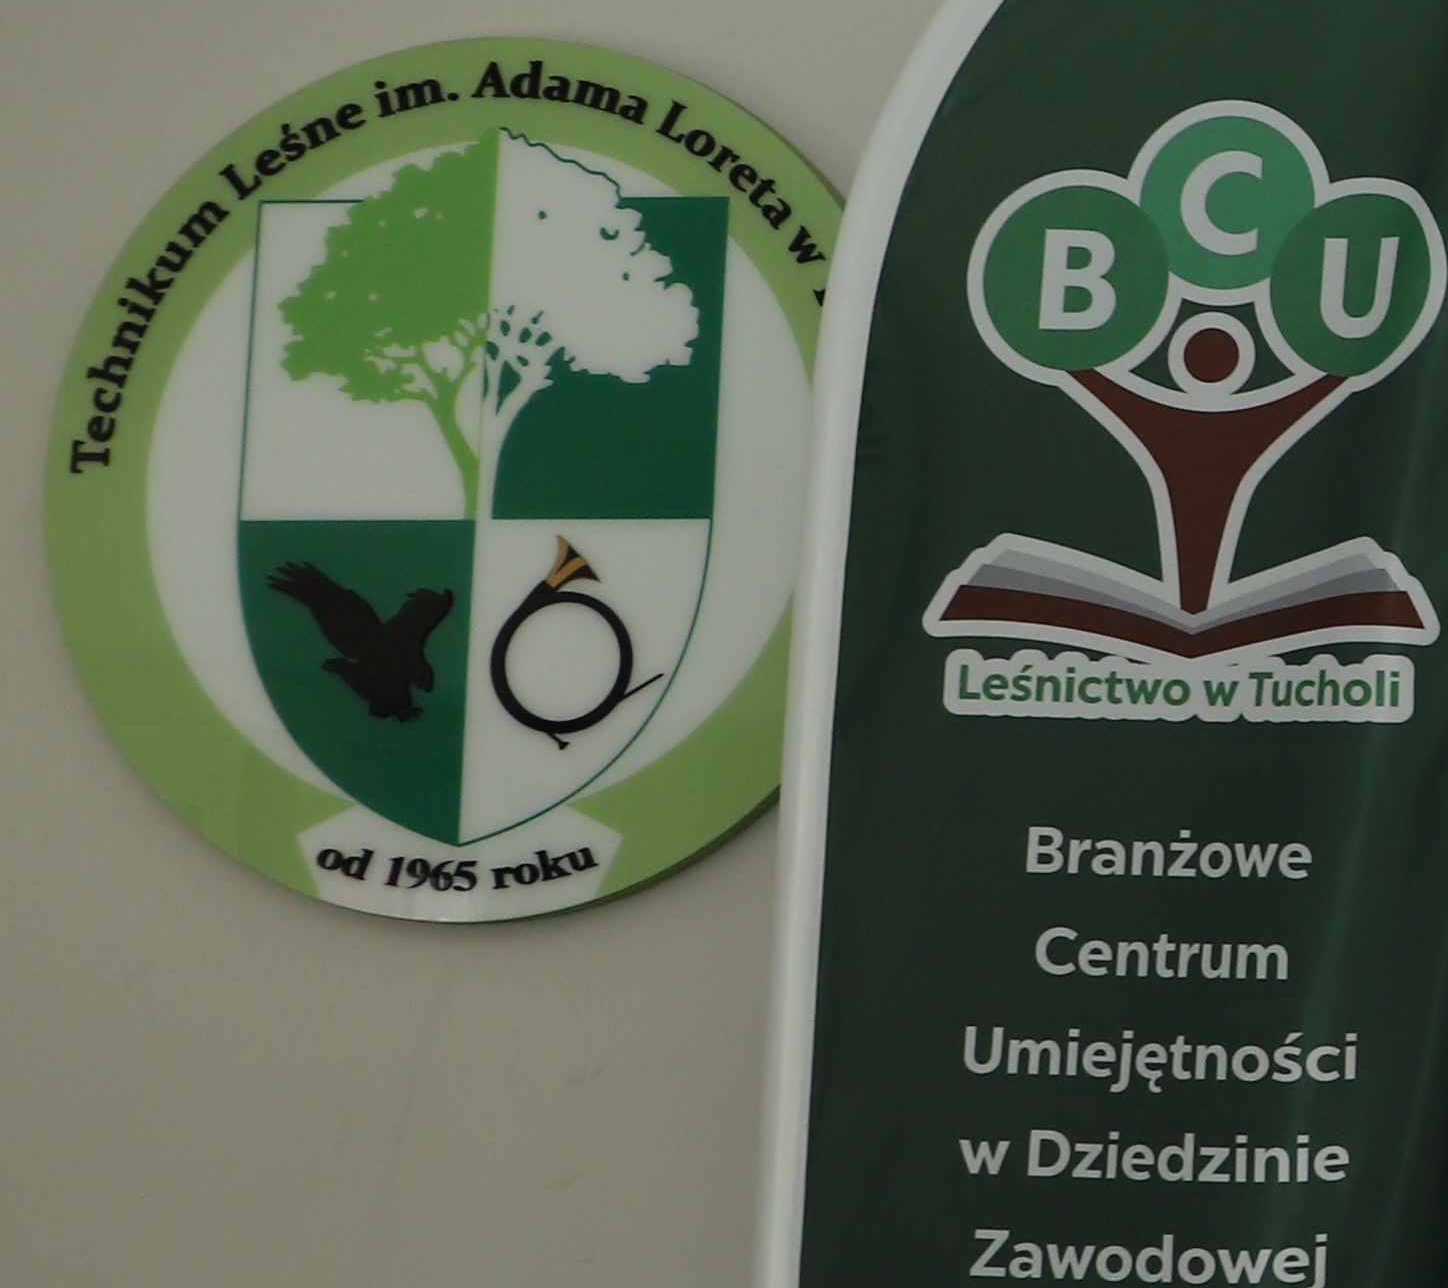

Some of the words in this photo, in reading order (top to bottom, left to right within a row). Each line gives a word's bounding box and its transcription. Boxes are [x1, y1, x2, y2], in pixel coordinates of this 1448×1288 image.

[69, 199, 230, 474] Technikum
[219, 101, 366, 201] Leśne
[374, 76, 460, 118] im.
[471, 60, 649, 125] Adama
[655, 99, 792, 231] Loreta
[788, 225, 826, 265] w
[957, 663, 1191, 707] Leśnictwo
[1204, 676, 1239, 707] w
[1247, 670, 1400, 708] Tucholi
[316, 848, 375, 881] od
[384, 856, 478, 891] 1965
[490, 847, 600, 889] roku
[1024, 826, 1313, 879] Branżowe
[1034, 927, 1289, 980] Centrum
[962, 1025, 1359, 1094] Umiejętności
[958, 1138, 1011, 1176] w
[1027, 1129, 1351, 1183] Dziedzinie
